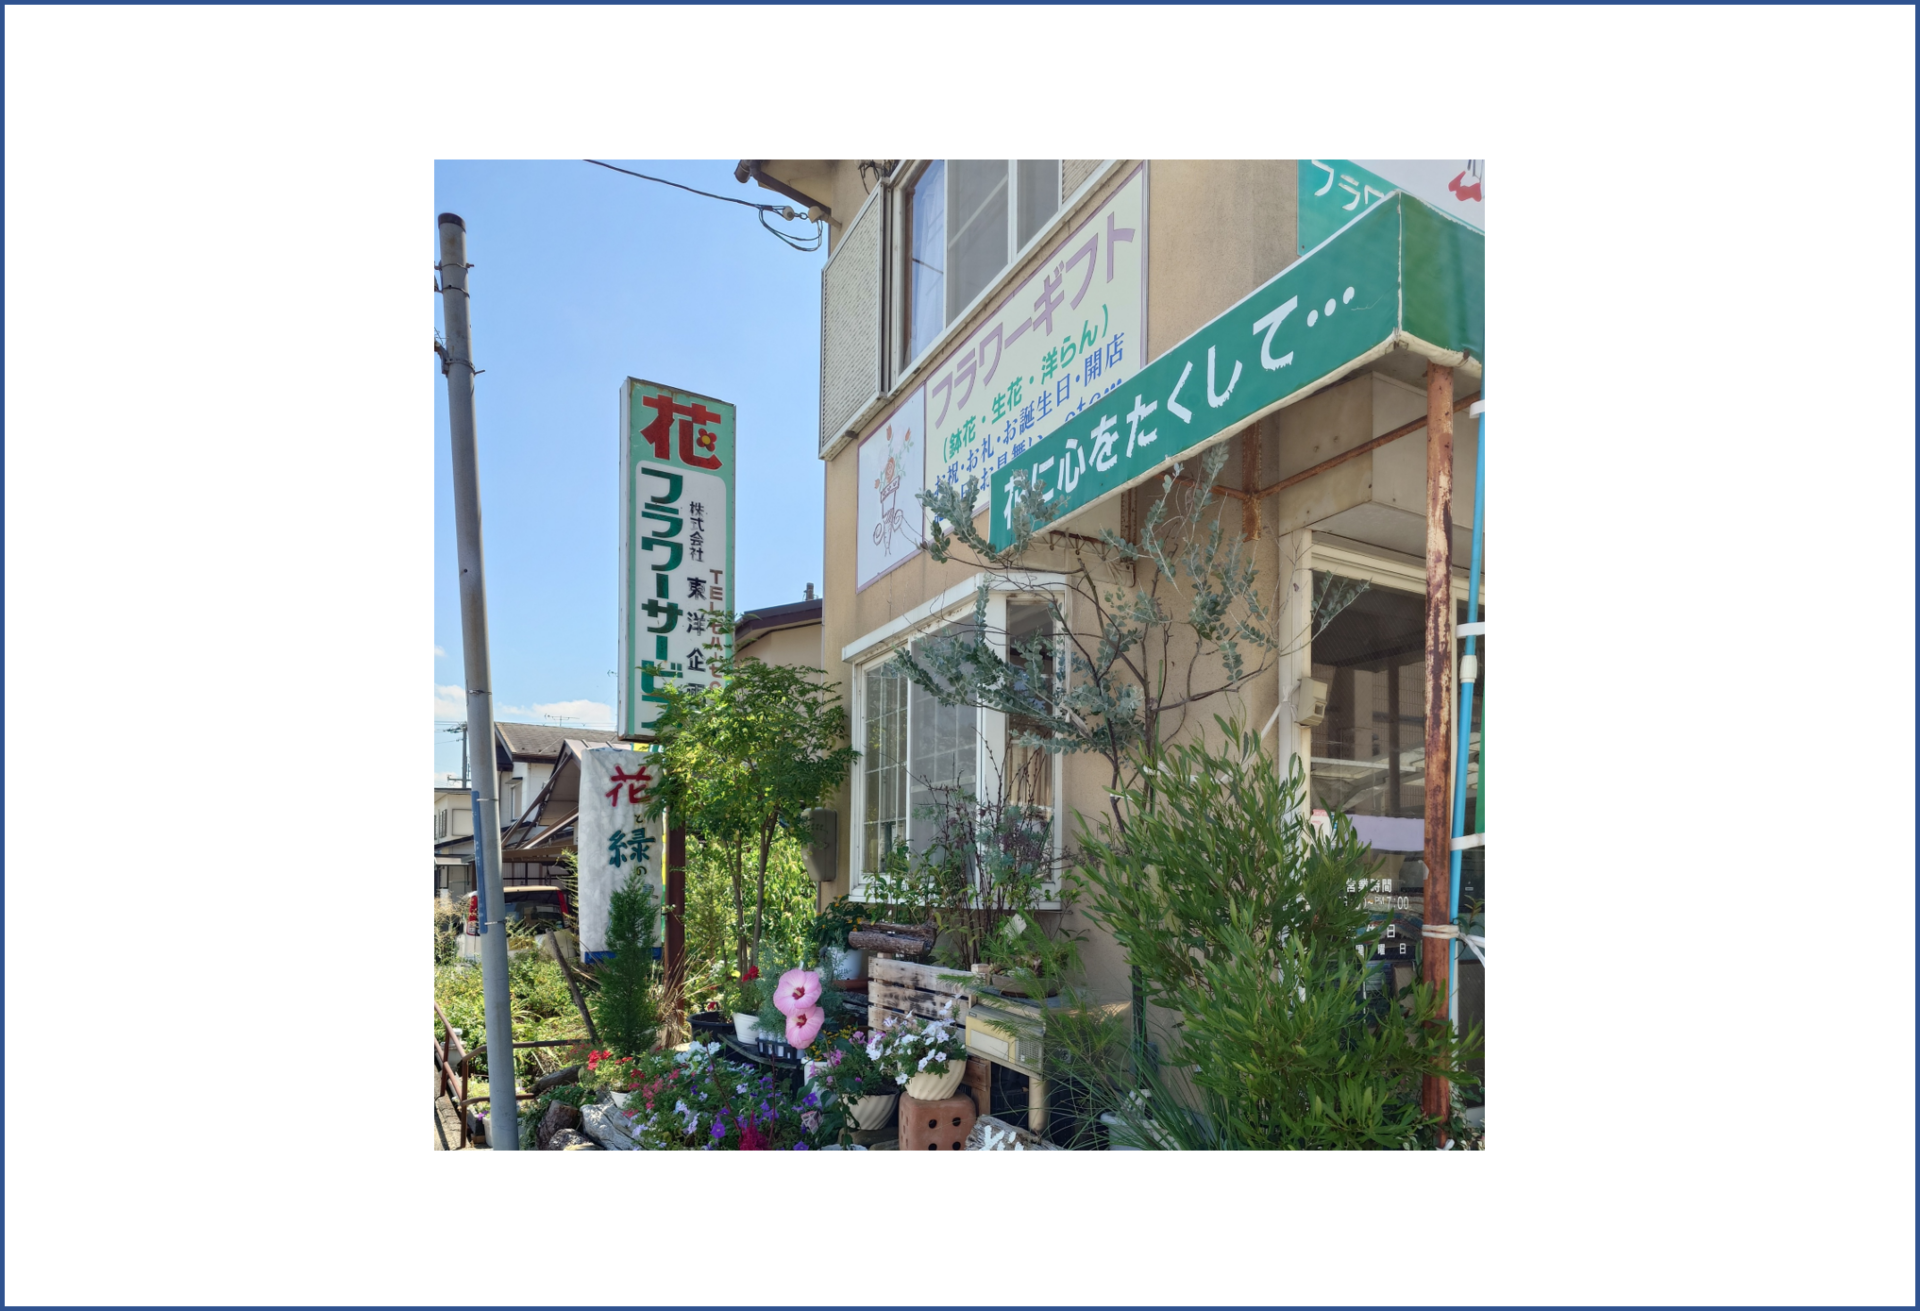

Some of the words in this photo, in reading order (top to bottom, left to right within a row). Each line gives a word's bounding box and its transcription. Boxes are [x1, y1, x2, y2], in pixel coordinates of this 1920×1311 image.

[931, 211, 1136, 430] フラワーギフト
[640, 394, 723, 471] 花
[689, 501, 705, 562] 株式会社
